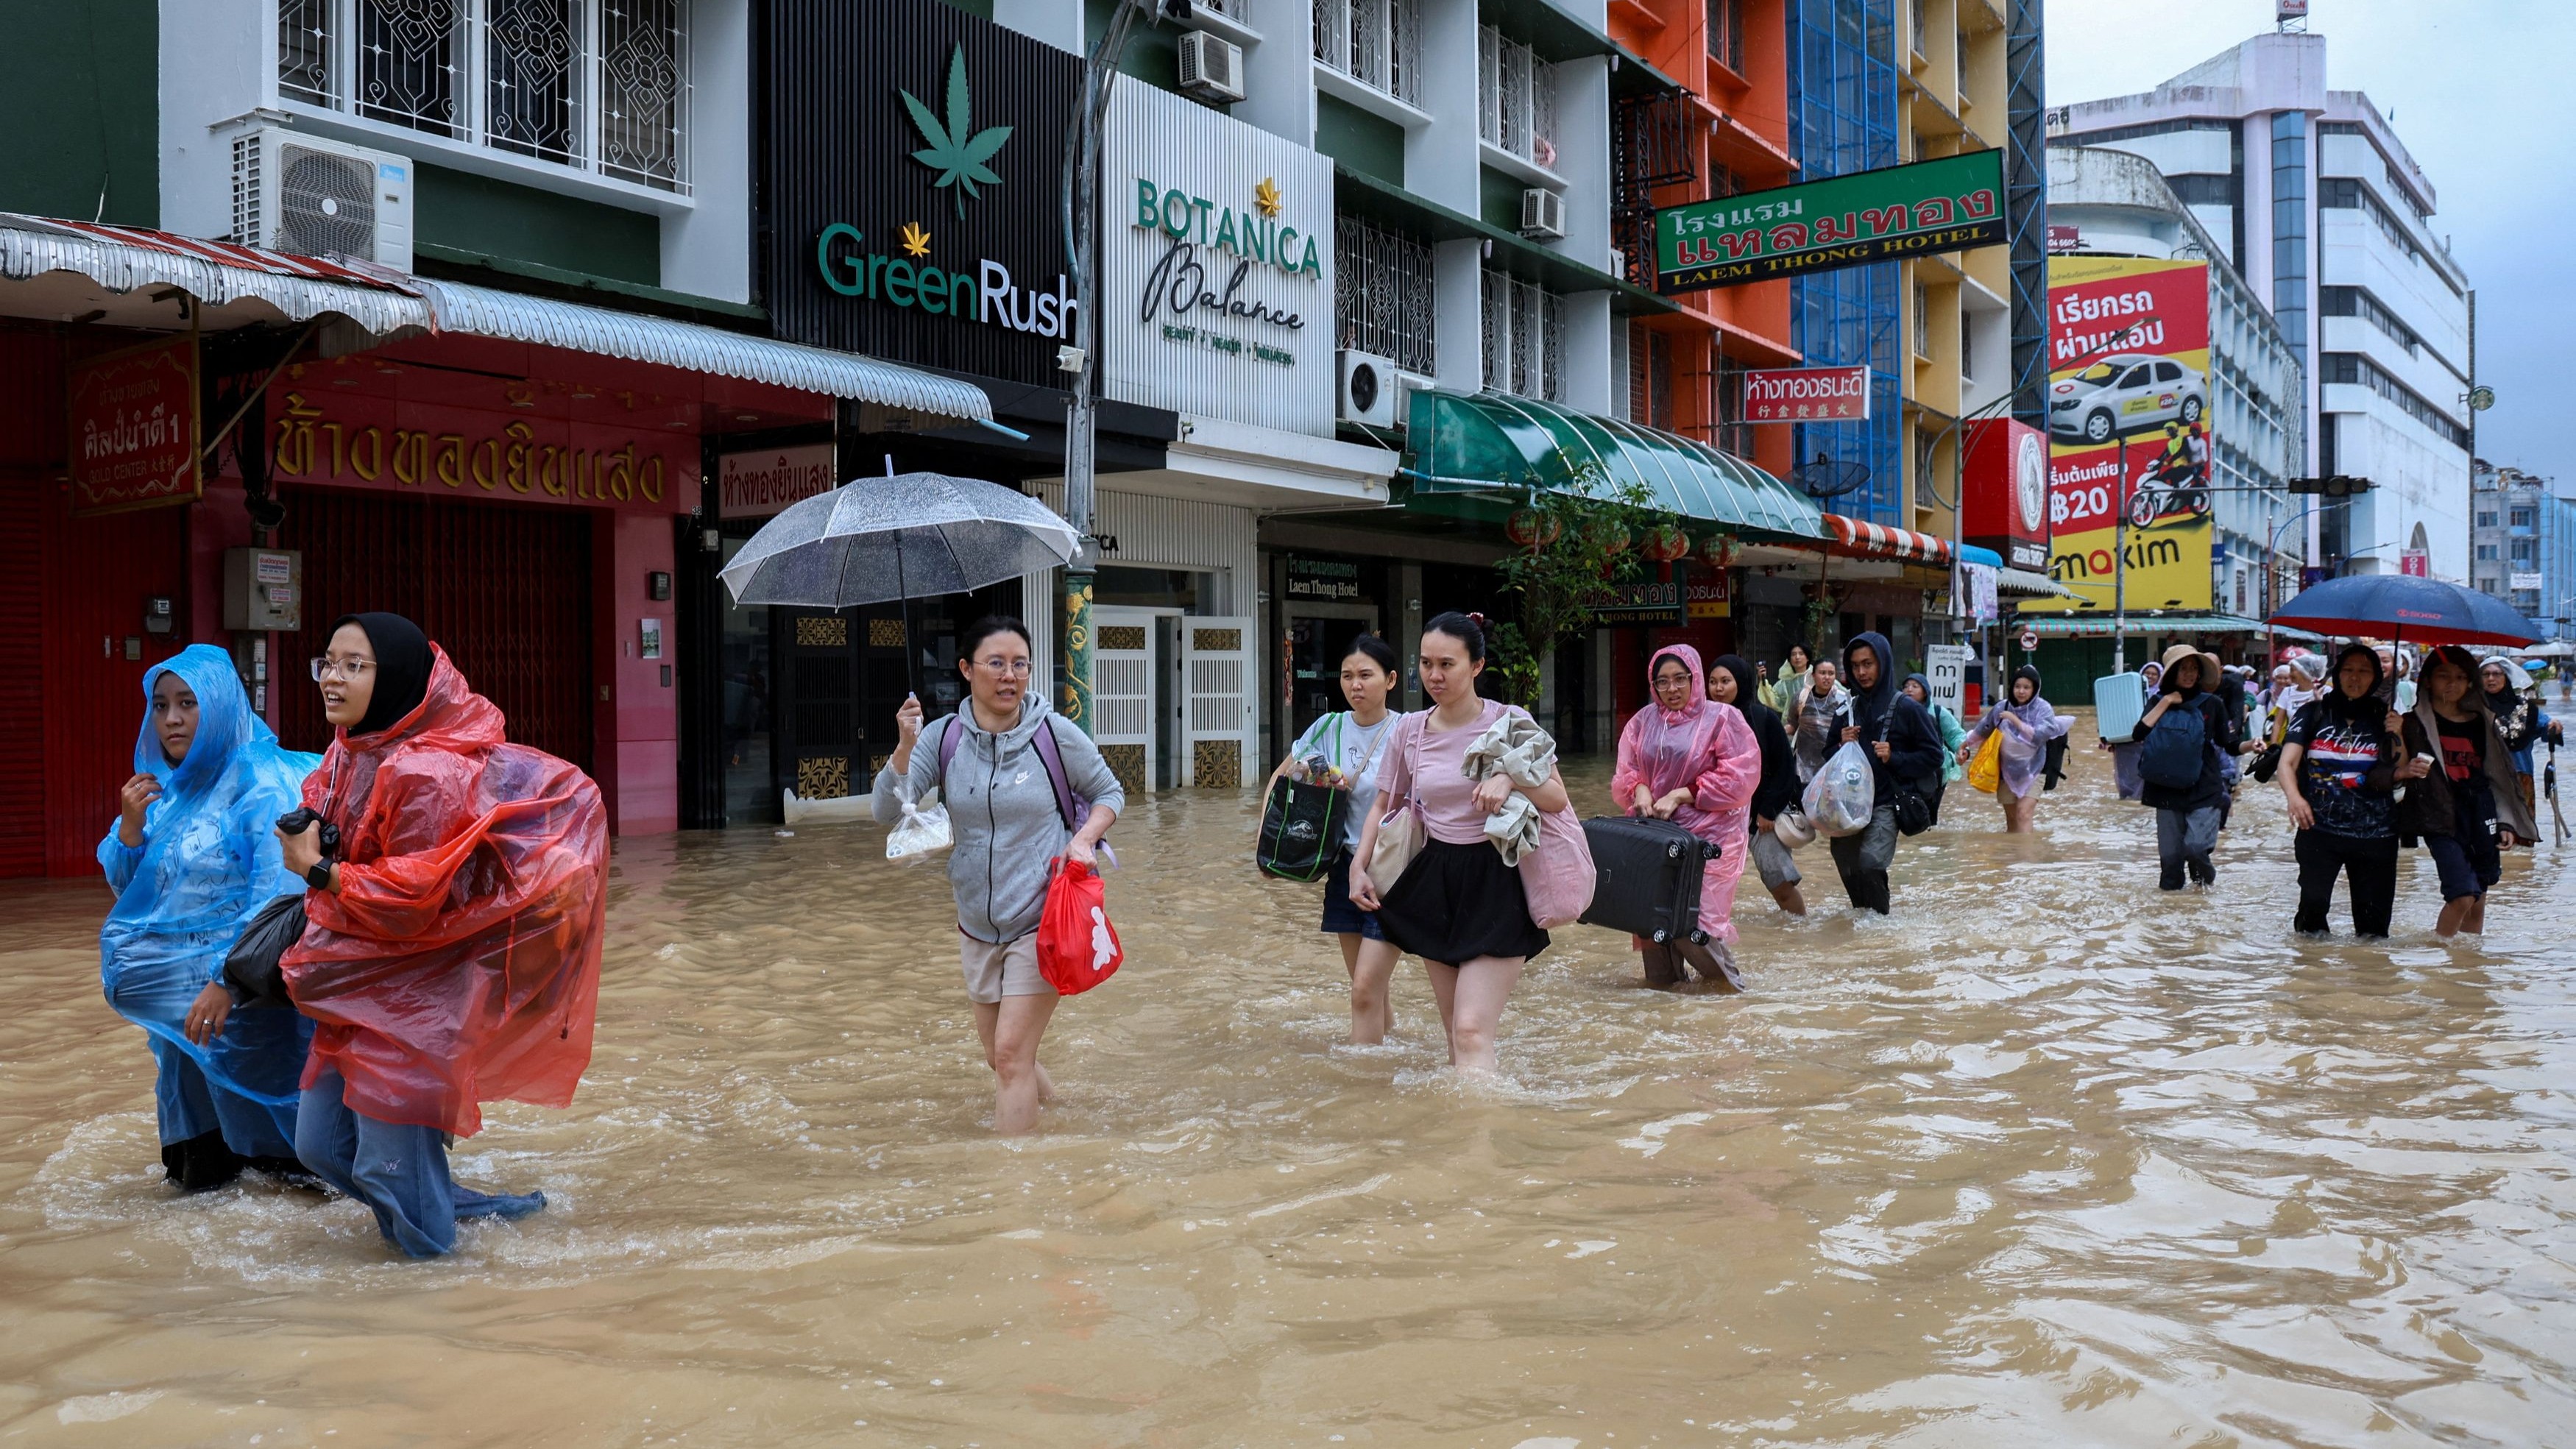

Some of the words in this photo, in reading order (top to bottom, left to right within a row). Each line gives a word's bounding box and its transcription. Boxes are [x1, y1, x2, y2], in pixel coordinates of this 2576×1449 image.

[1133, 177, 1322, 280] BOTANICA
[1667, 198, 1803, 235] โรงแรม
[1677, 188, 1995, 266] แหลมทอง
[1673, 263, 1752, 286] LAEM
[1764, 243, 1869, 271] THONG
[1883, 227, 1990, 252] HOTEL
[1142, 238, 1305, 330] Balance
[2056, 291, 2154, 325] เรียกรถ
[1747, 369, 1863, 400] ห้างทองธนะดี
[276, 392, 662, 503] ห้างทองยินแสง
[88, 467, 111, 484] GOLD
[113, 460, 147, 480] CENTER
[2051, 534, 2180, 580] maxim
[1289, 578, 1310, 595] Laem
[1311, 578, 1337, 599] Thong
[1338, 581, 1359, 597] Hotel
[1638, 611, 1676, 621] HOTEL
[1017, 770, 1028, 779] NIKE
